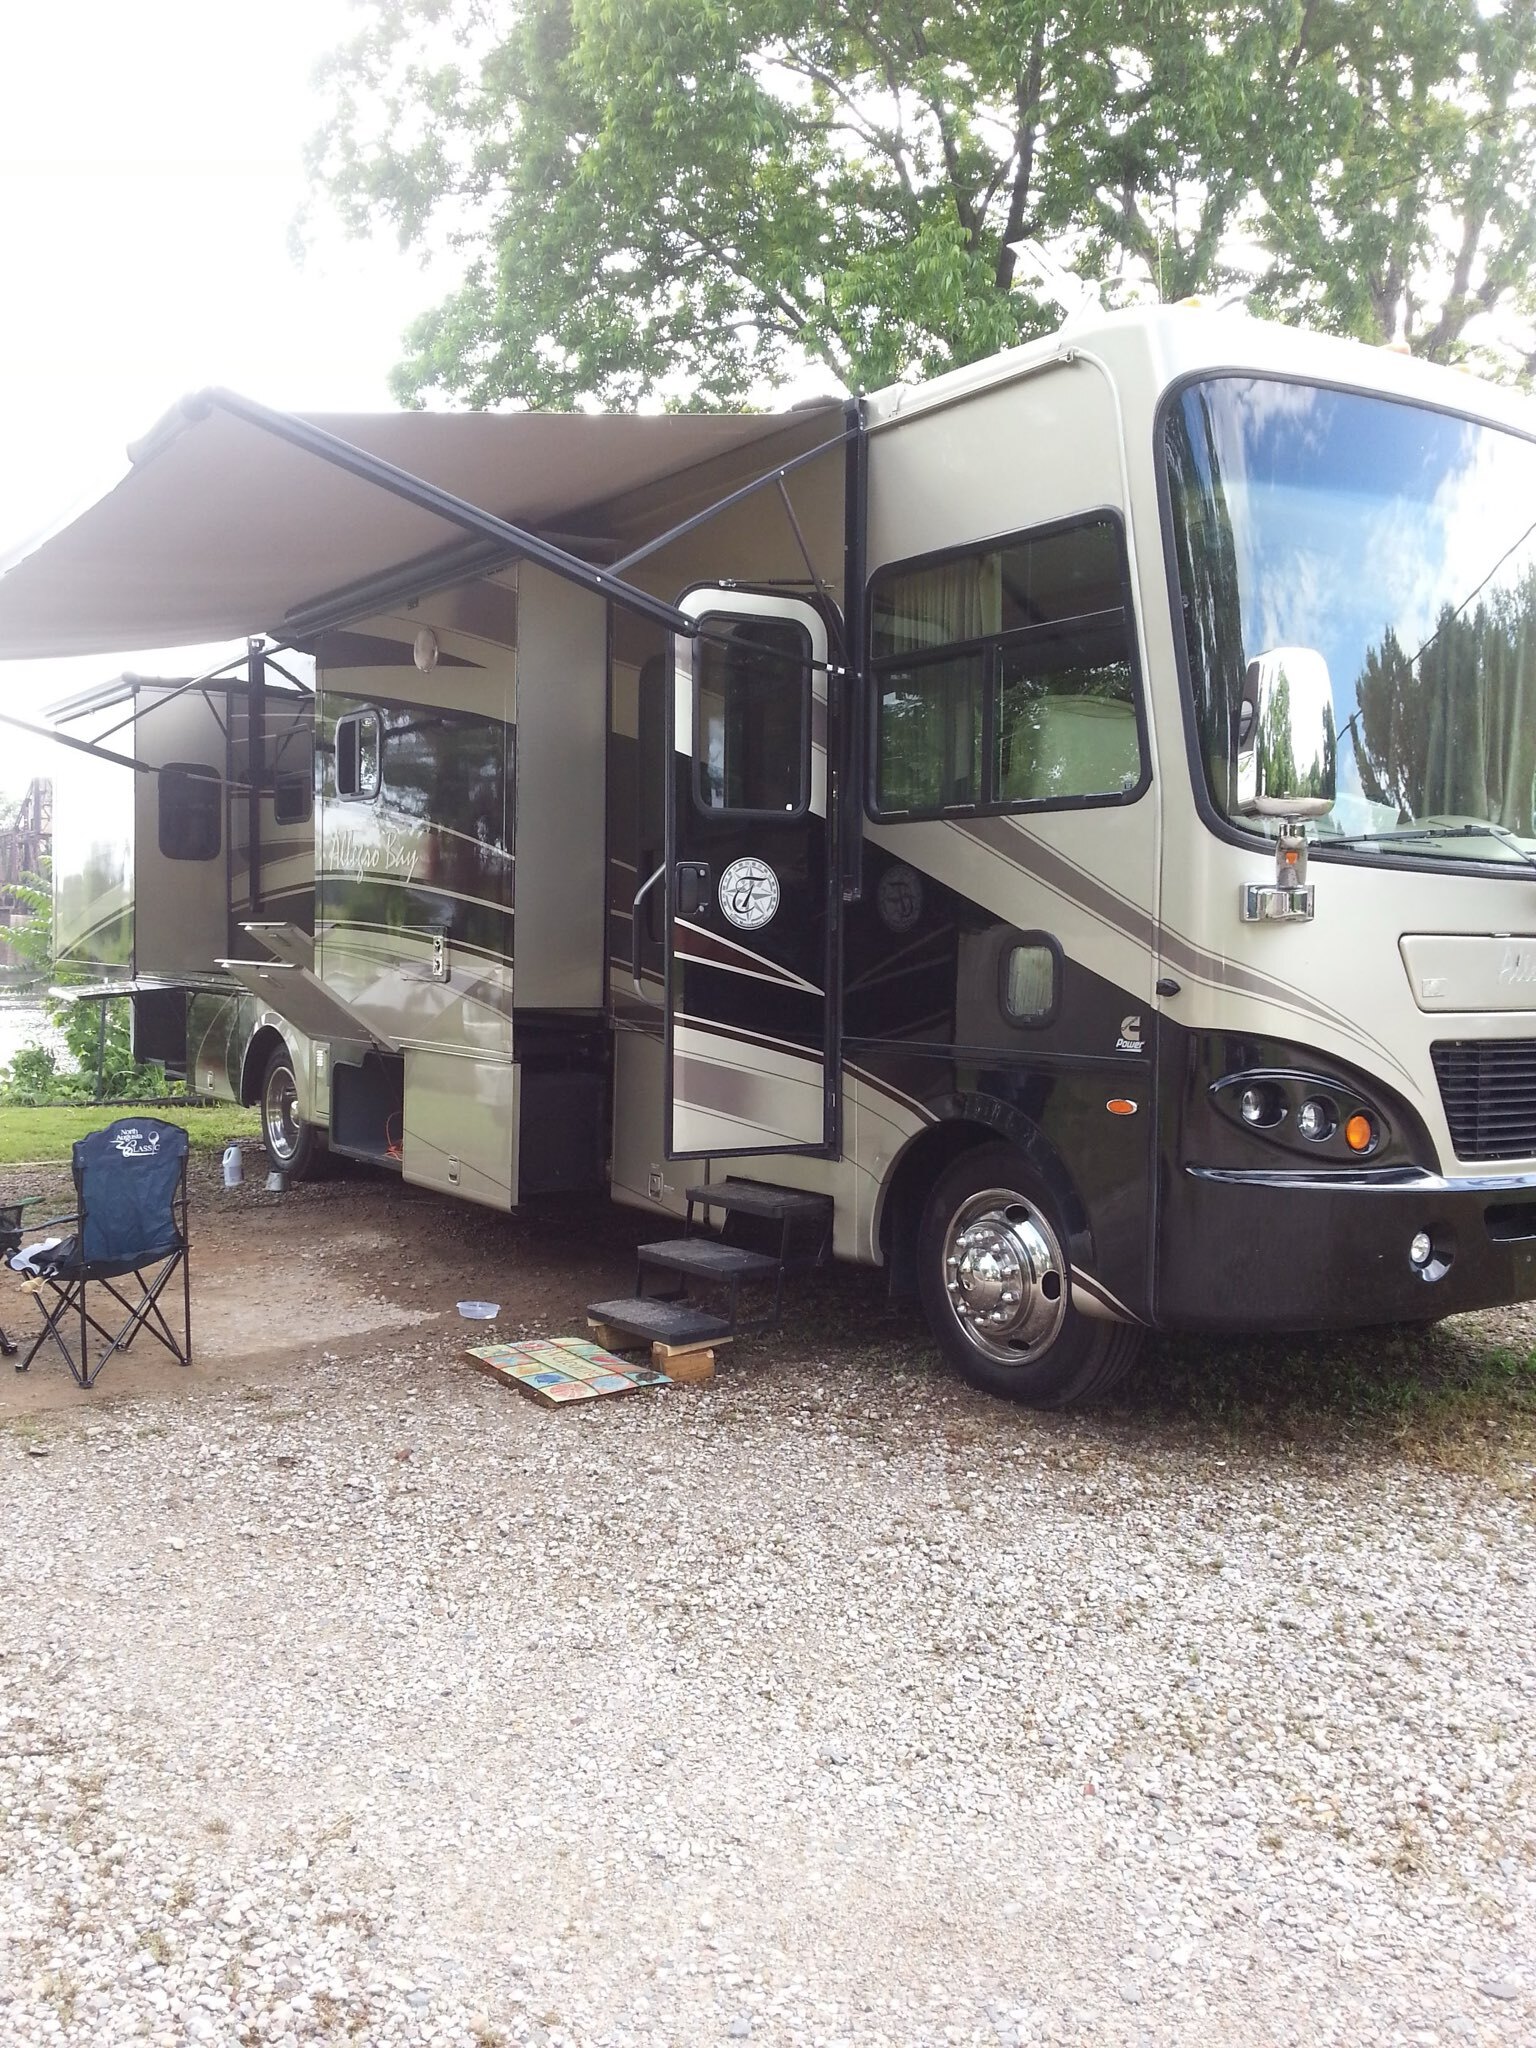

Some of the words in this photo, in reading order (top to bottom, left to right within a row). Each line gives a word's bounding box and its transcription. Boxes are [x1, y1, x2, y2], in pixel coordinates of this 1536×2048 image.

[384, 829, 419, 883] Bay
[1115, 1038, 1146, 1049] Power
[120, 1128, 139, 1136] North
[115, 1133, 143, 1142] Augusta
